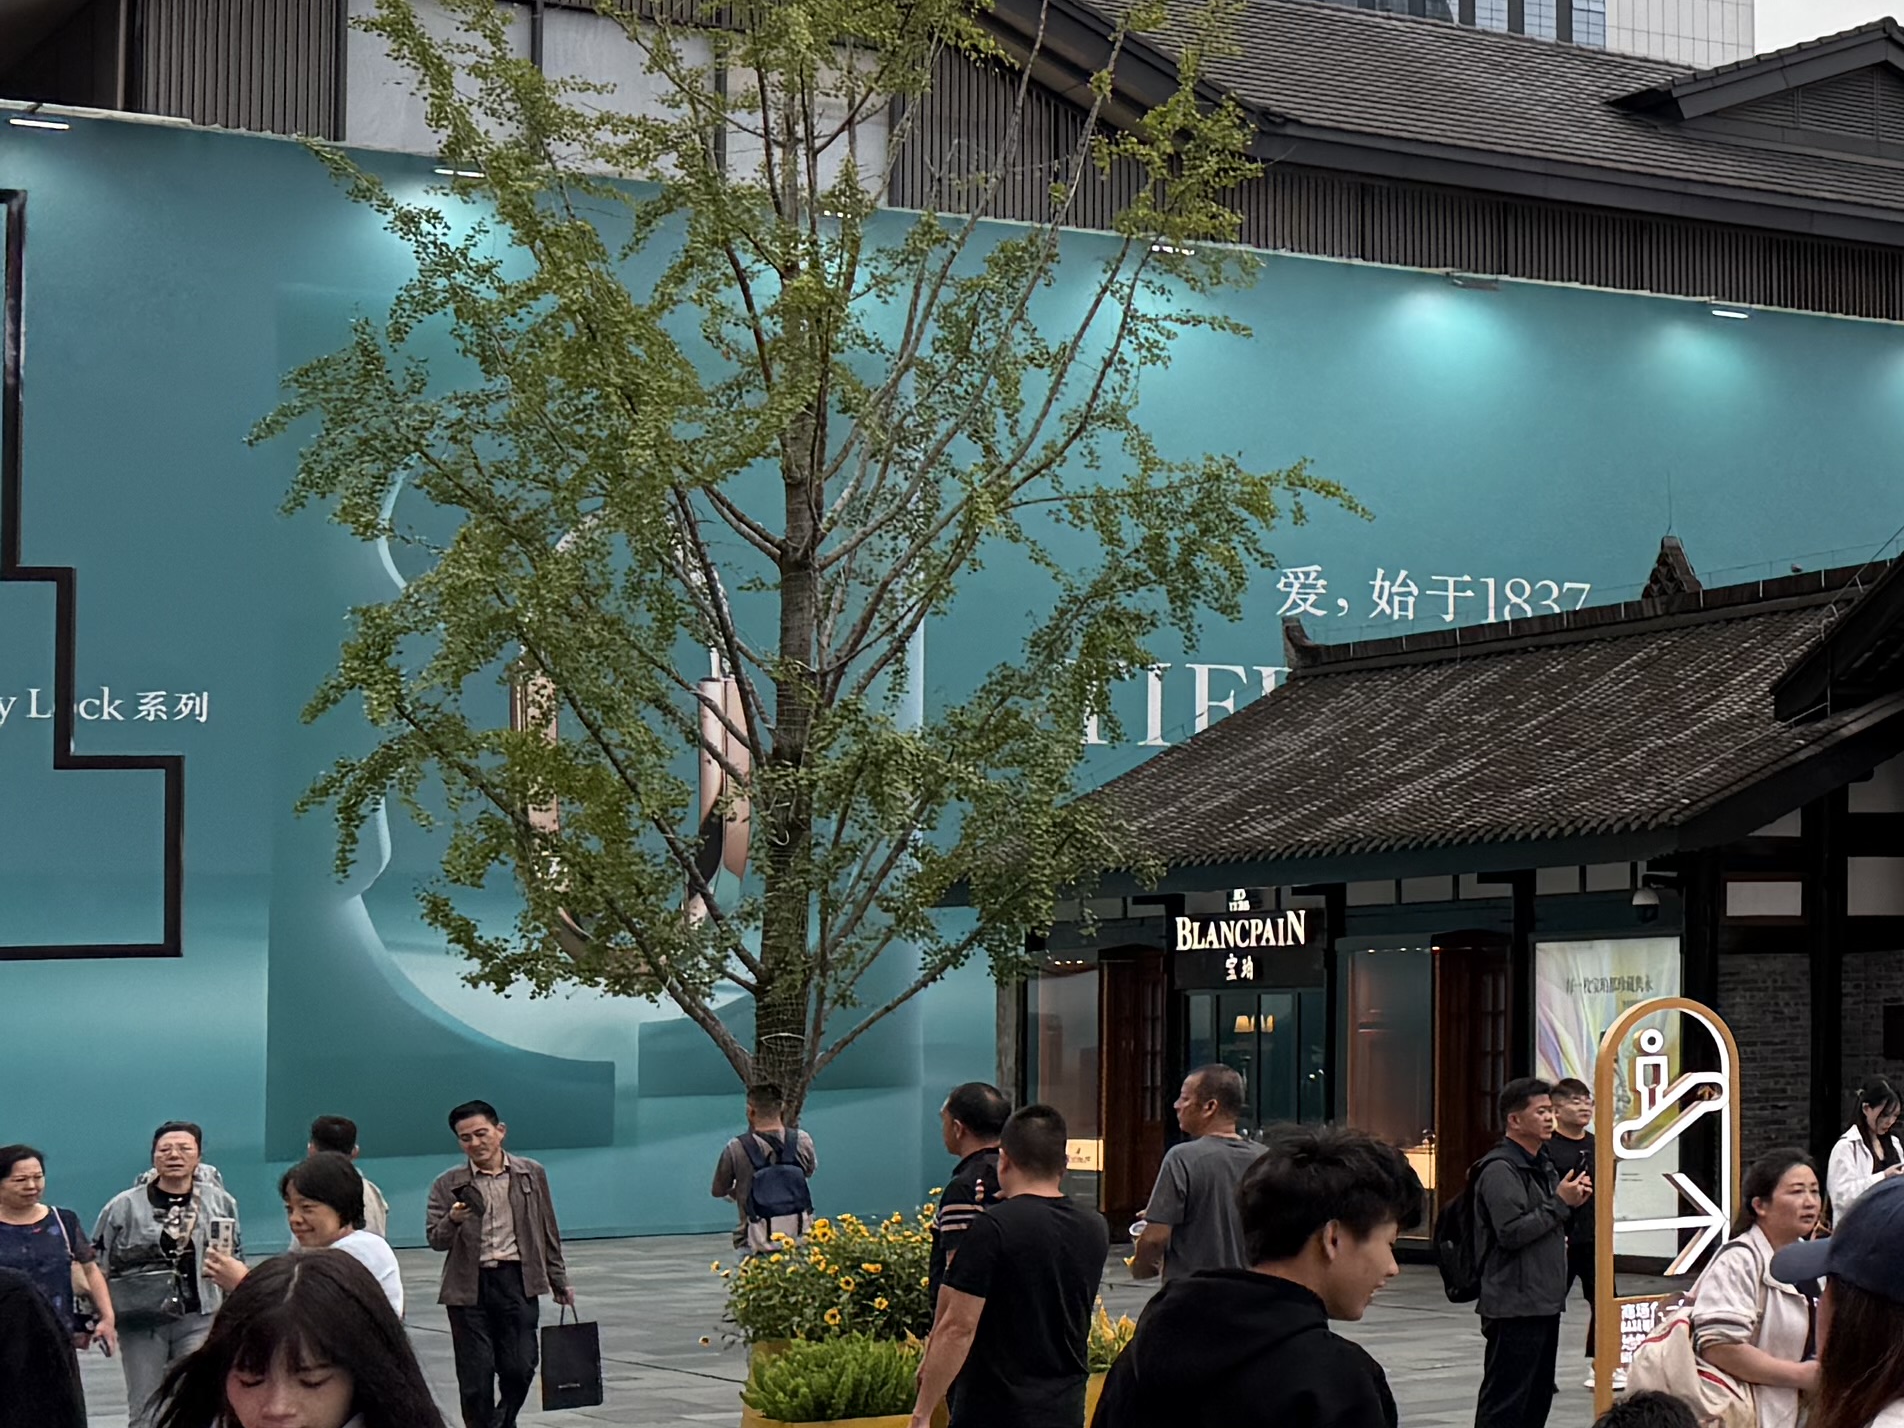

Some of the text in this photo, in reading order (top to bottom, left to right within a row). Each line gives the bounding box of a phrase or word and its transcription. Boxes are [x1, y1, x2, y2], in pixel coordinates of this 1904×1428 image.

[26, 686, 125, 721] Lck
[133, 690, 209, 723] 系列
[1175, 909, 1306, 951] BLANCPAIN
